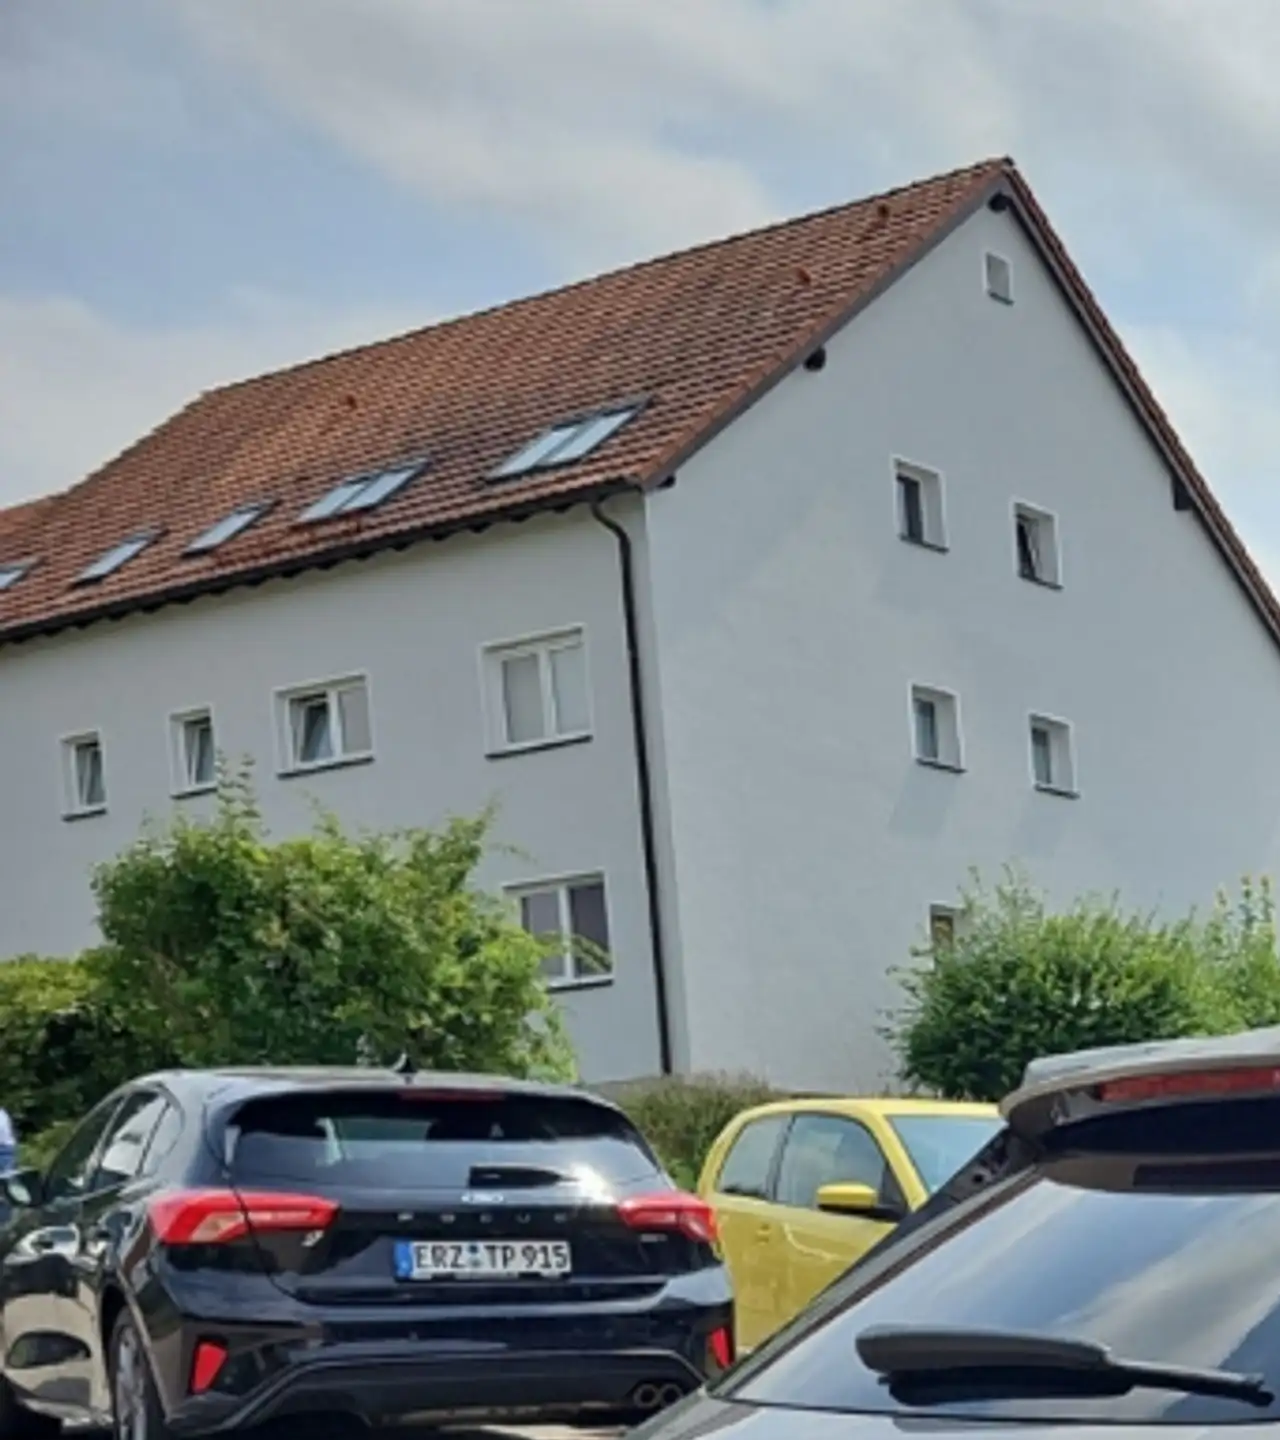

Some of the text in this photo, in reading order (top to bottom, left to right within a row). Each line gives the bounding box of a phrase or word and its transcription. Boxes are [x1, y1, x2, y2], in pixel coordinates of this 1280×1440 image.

[415, 1244, 568, 1270] ERZ TP 915
